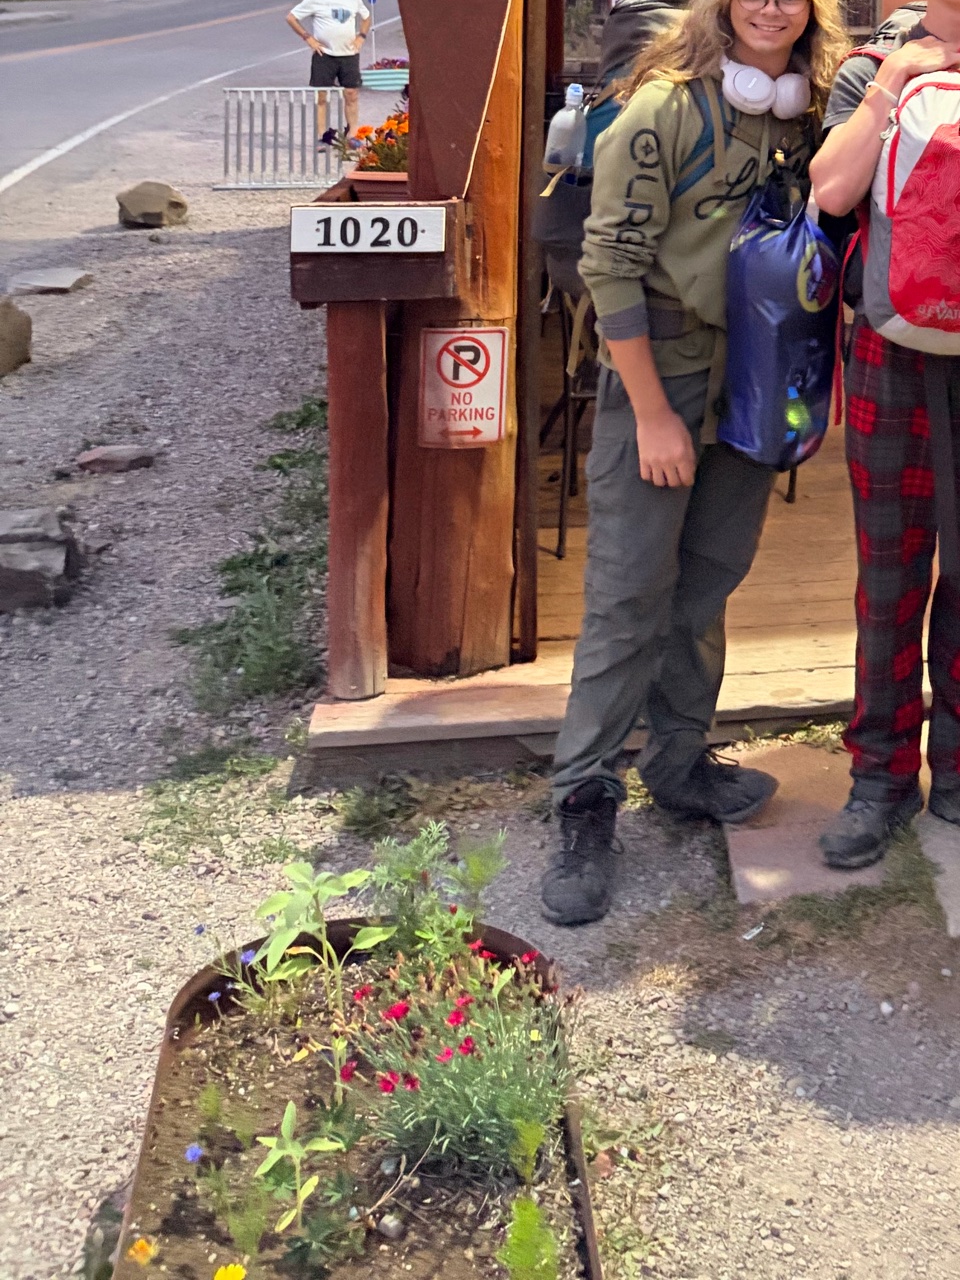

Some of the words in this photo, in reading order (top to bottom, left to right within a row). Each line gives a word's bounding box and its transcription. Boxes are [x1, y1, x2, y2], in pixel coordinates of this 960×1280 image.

[316, 216, 419, 248] 1020
[451, 391, 474, 407] NO
[427, 406, 496, 423] PARKING
